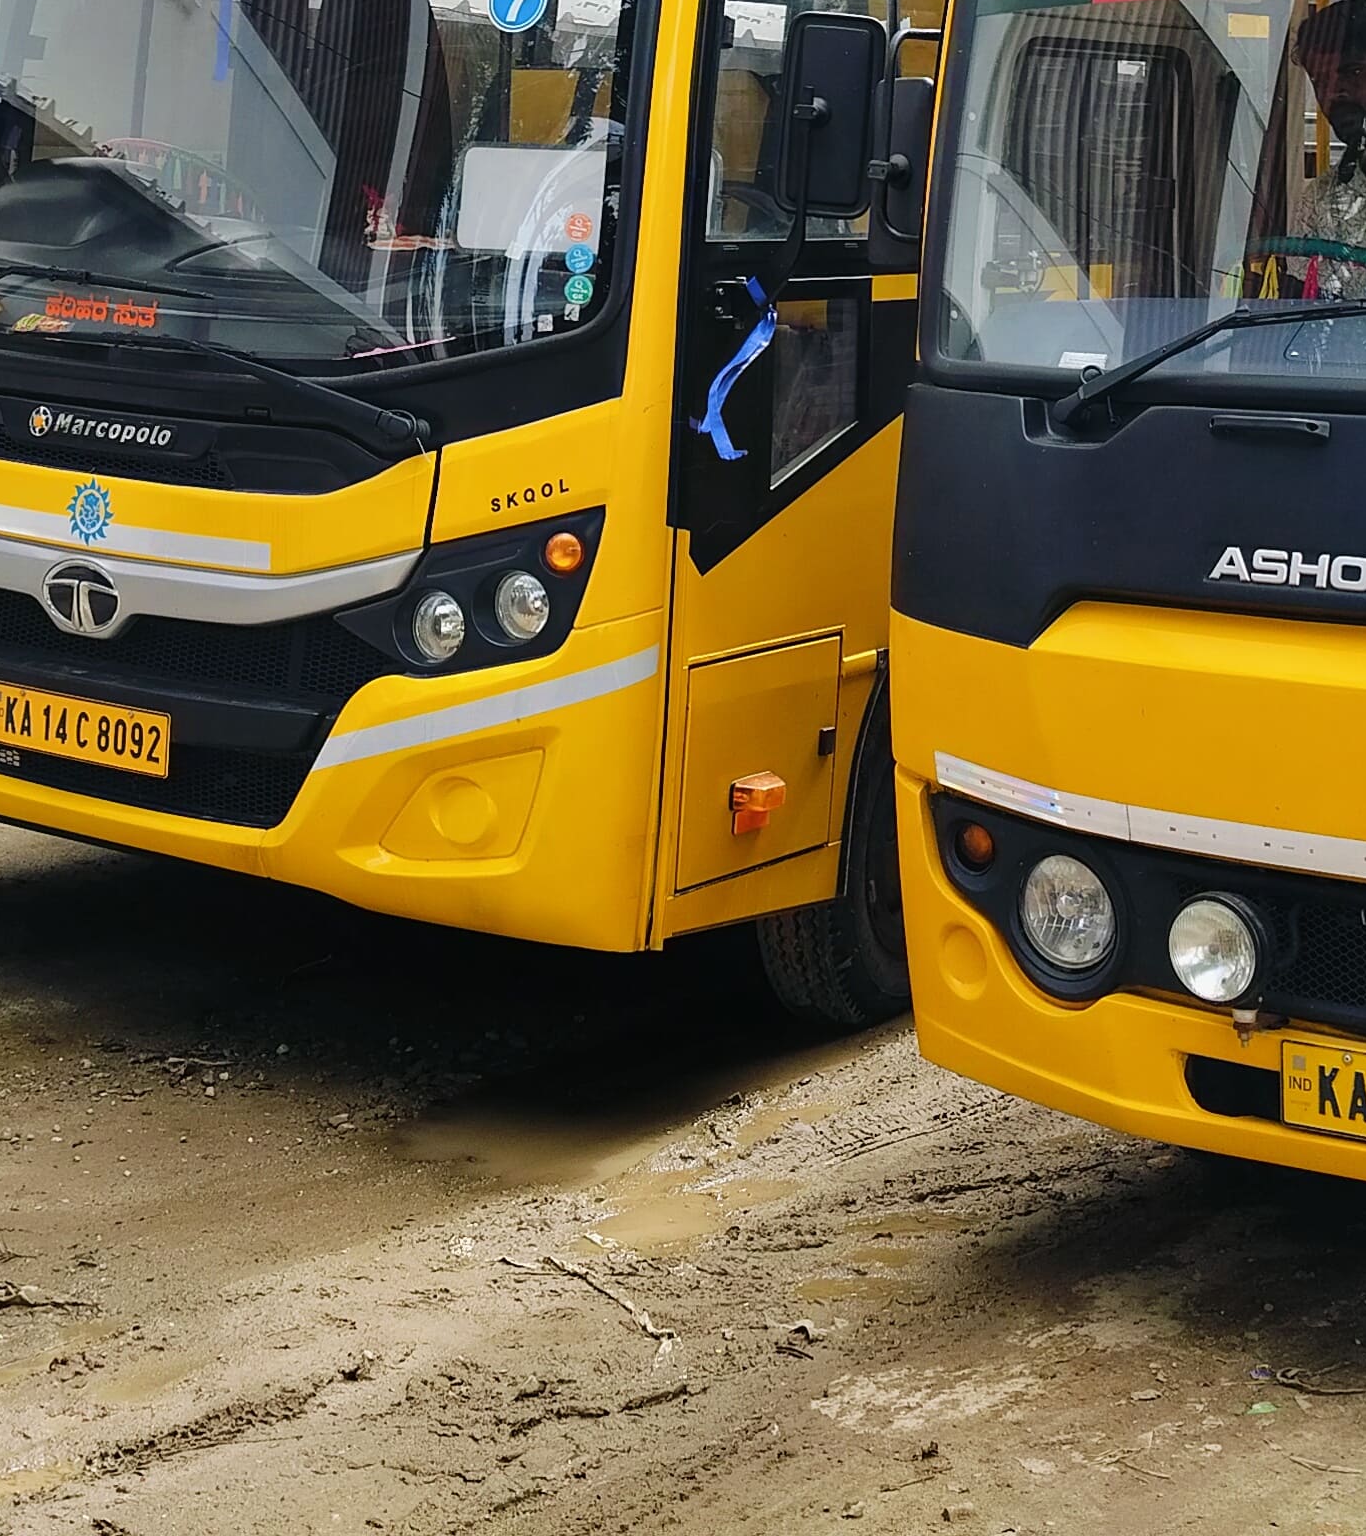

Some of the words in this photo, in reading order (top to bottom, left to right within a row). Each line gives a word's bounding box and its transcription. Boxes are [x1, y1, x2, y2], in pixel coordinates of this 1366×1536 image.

[45, 291, 110, 322] ಹರಿಹರ
[113, 298, 159, 329] ಸುತ
[53, 412, 172, 447] Marcopolo
[5, 696, 31, 737] KA
[43, 704, 68, 745] 14
[76, 711, 90, 749] C
[97, 715, 162, 764] 8092
[1288, 1075, 1312, 1092] IND
